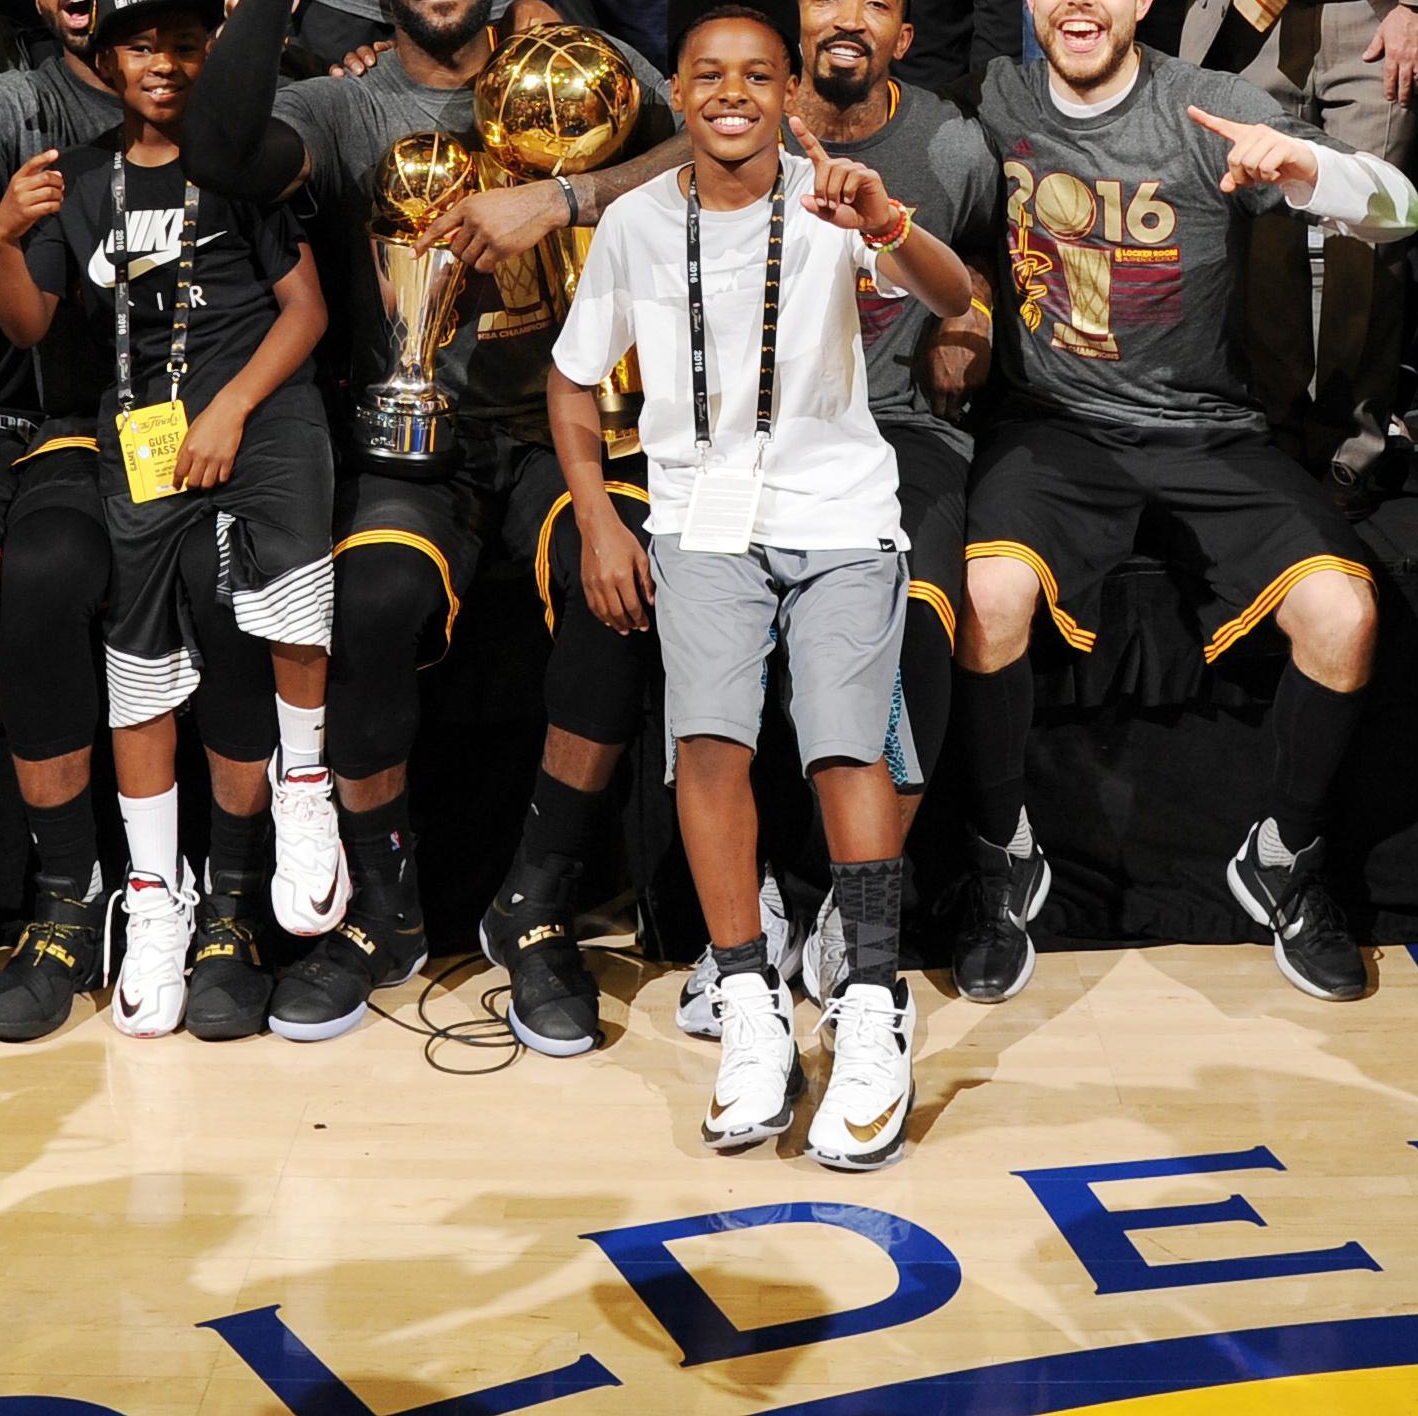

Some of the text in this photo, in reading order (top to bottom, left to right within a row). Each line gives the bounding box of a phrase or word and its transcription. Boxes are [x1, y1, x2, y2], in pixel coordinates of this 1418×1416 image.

[115, 229, 125, 251] 2016
[689, 260, 699, 285] 2016
[128, 285, 208, 312] IR
[117, 313, 127, 336] 2016
[693, 349, 703, 373] 2016
[149, 432, 181, 448] GUEST
[151, 445, 177, 459] PASS
